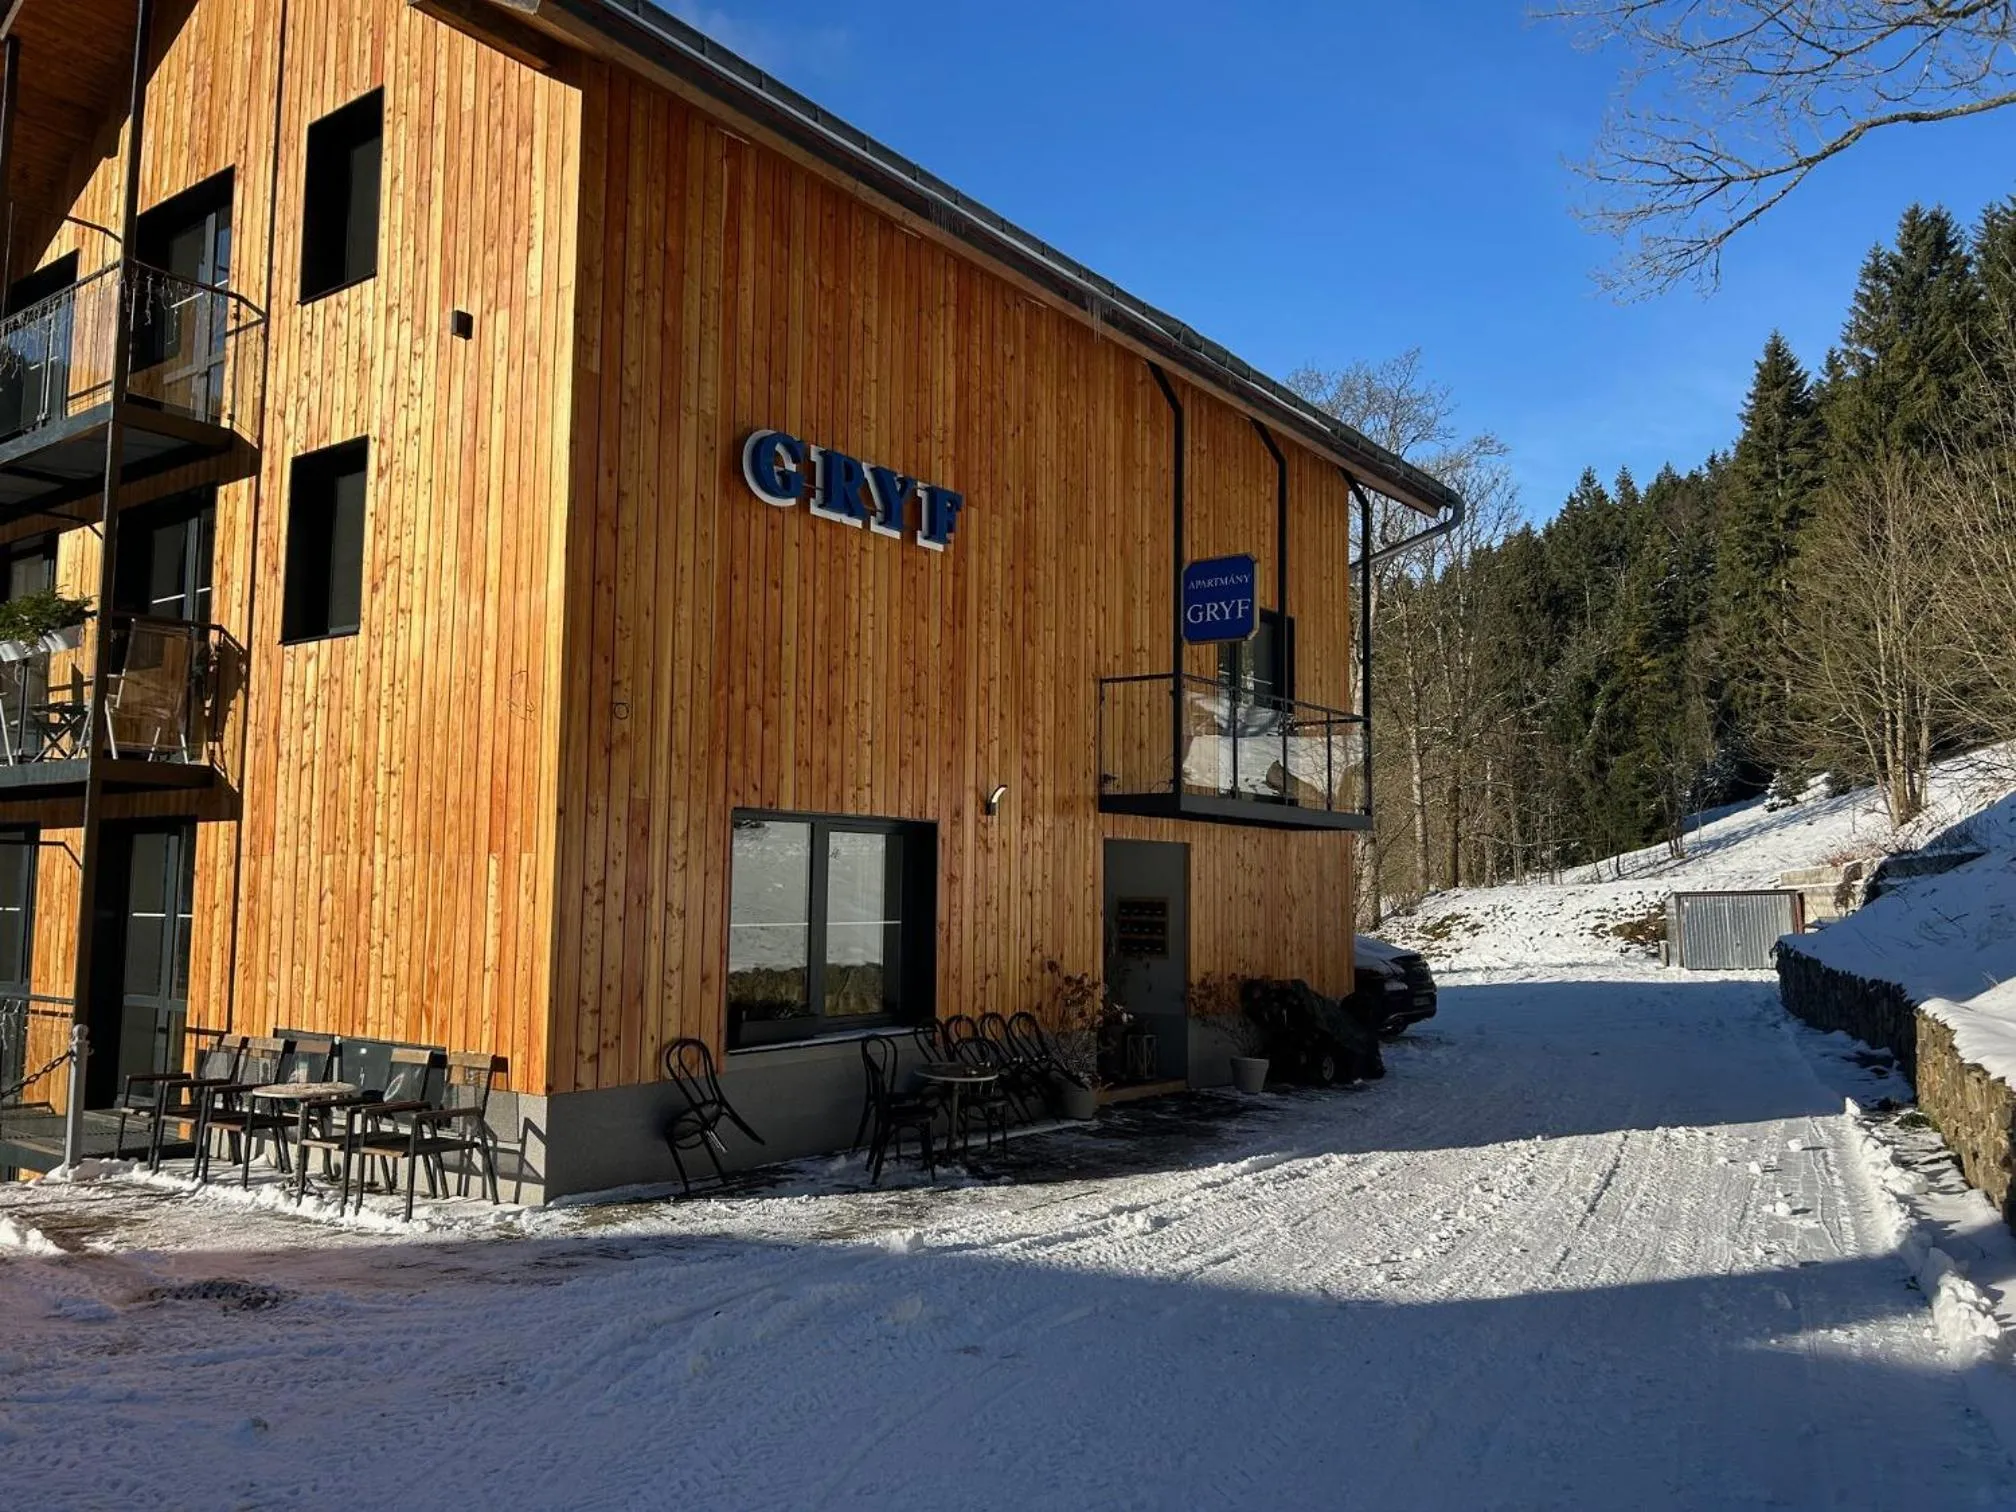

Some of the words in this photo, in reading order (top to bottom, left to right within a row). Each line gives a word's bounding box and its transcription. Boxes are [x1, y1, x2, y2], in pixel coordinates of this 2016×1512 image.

[742, 429, 963, 551] GRYF
[1188, 573, 1250, 590] APARTMÁNY
[1186, 598, 1251, 624] GRYF
